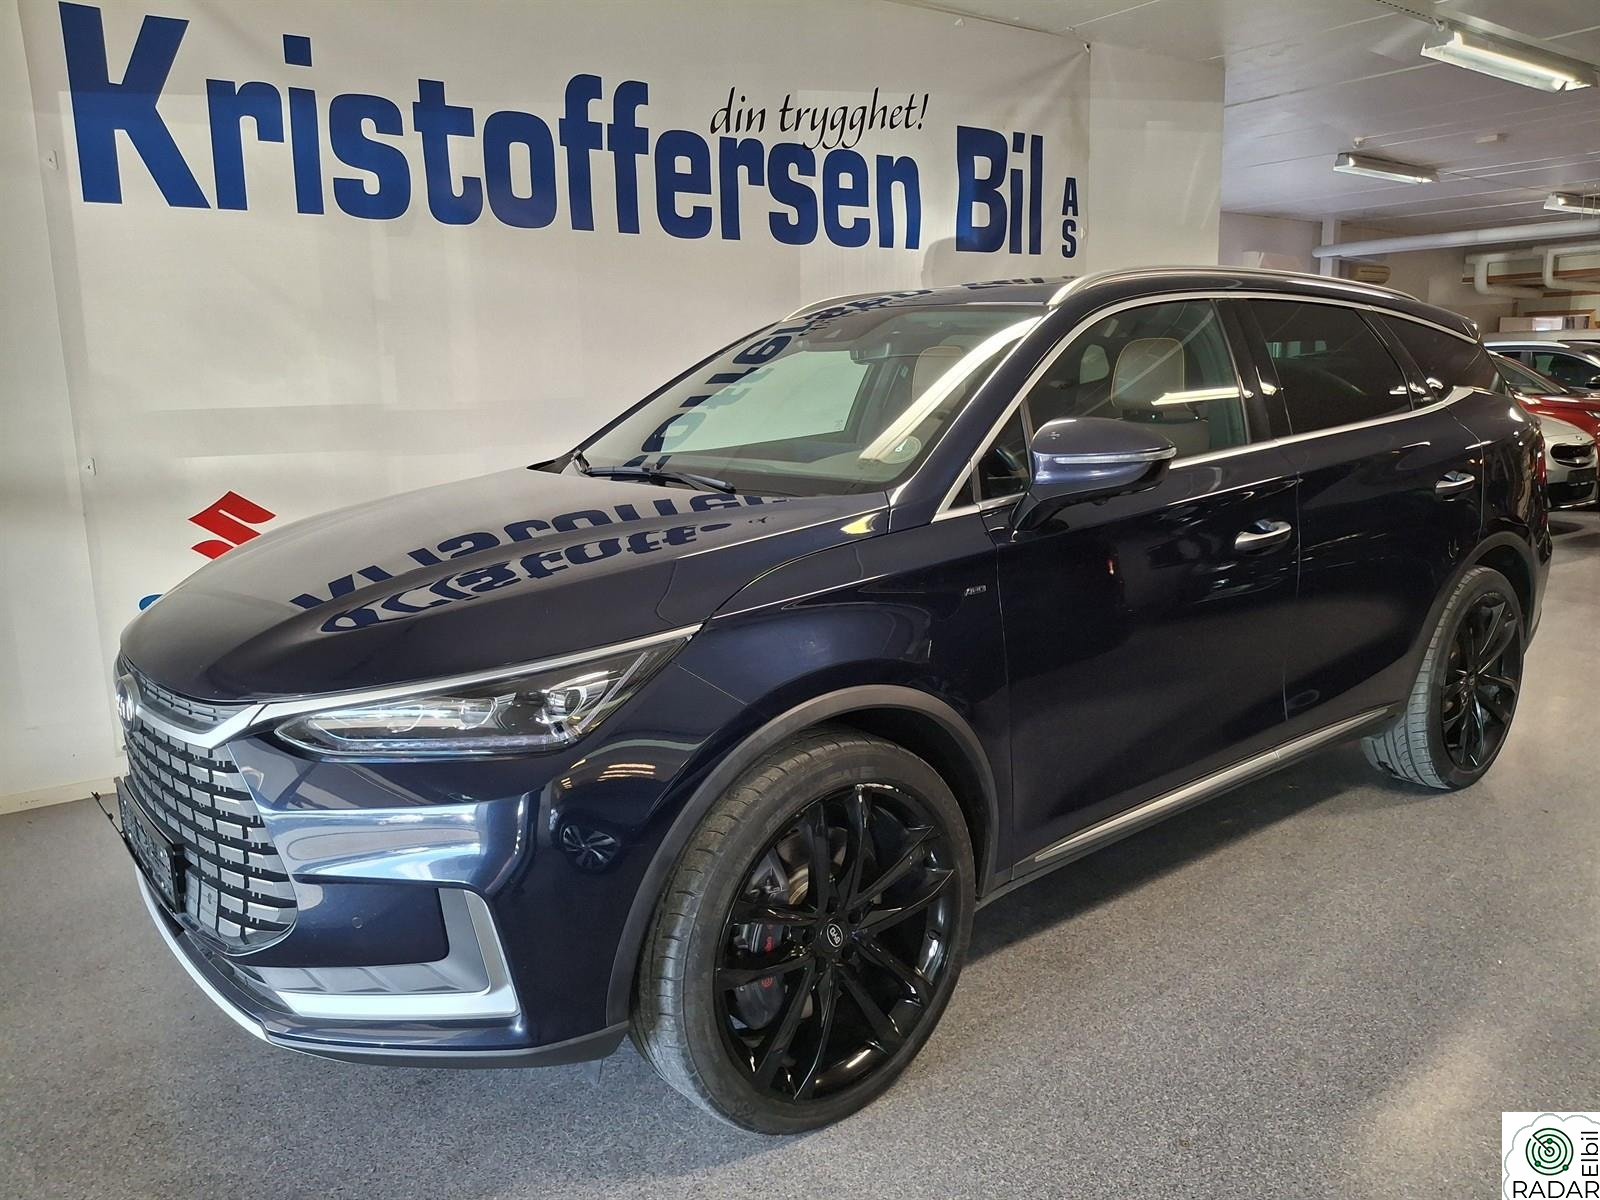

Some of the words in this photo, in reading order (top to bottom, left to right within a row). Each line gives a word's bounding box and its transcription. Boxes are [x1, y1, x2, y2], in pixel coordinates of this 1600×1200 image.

[59, 2, 922, 250] Kristoffersen
[956, 126, 1044, 255] Bil
[710, 87, 767, 134] din
[778, 87, 929, 150] trygghet!
